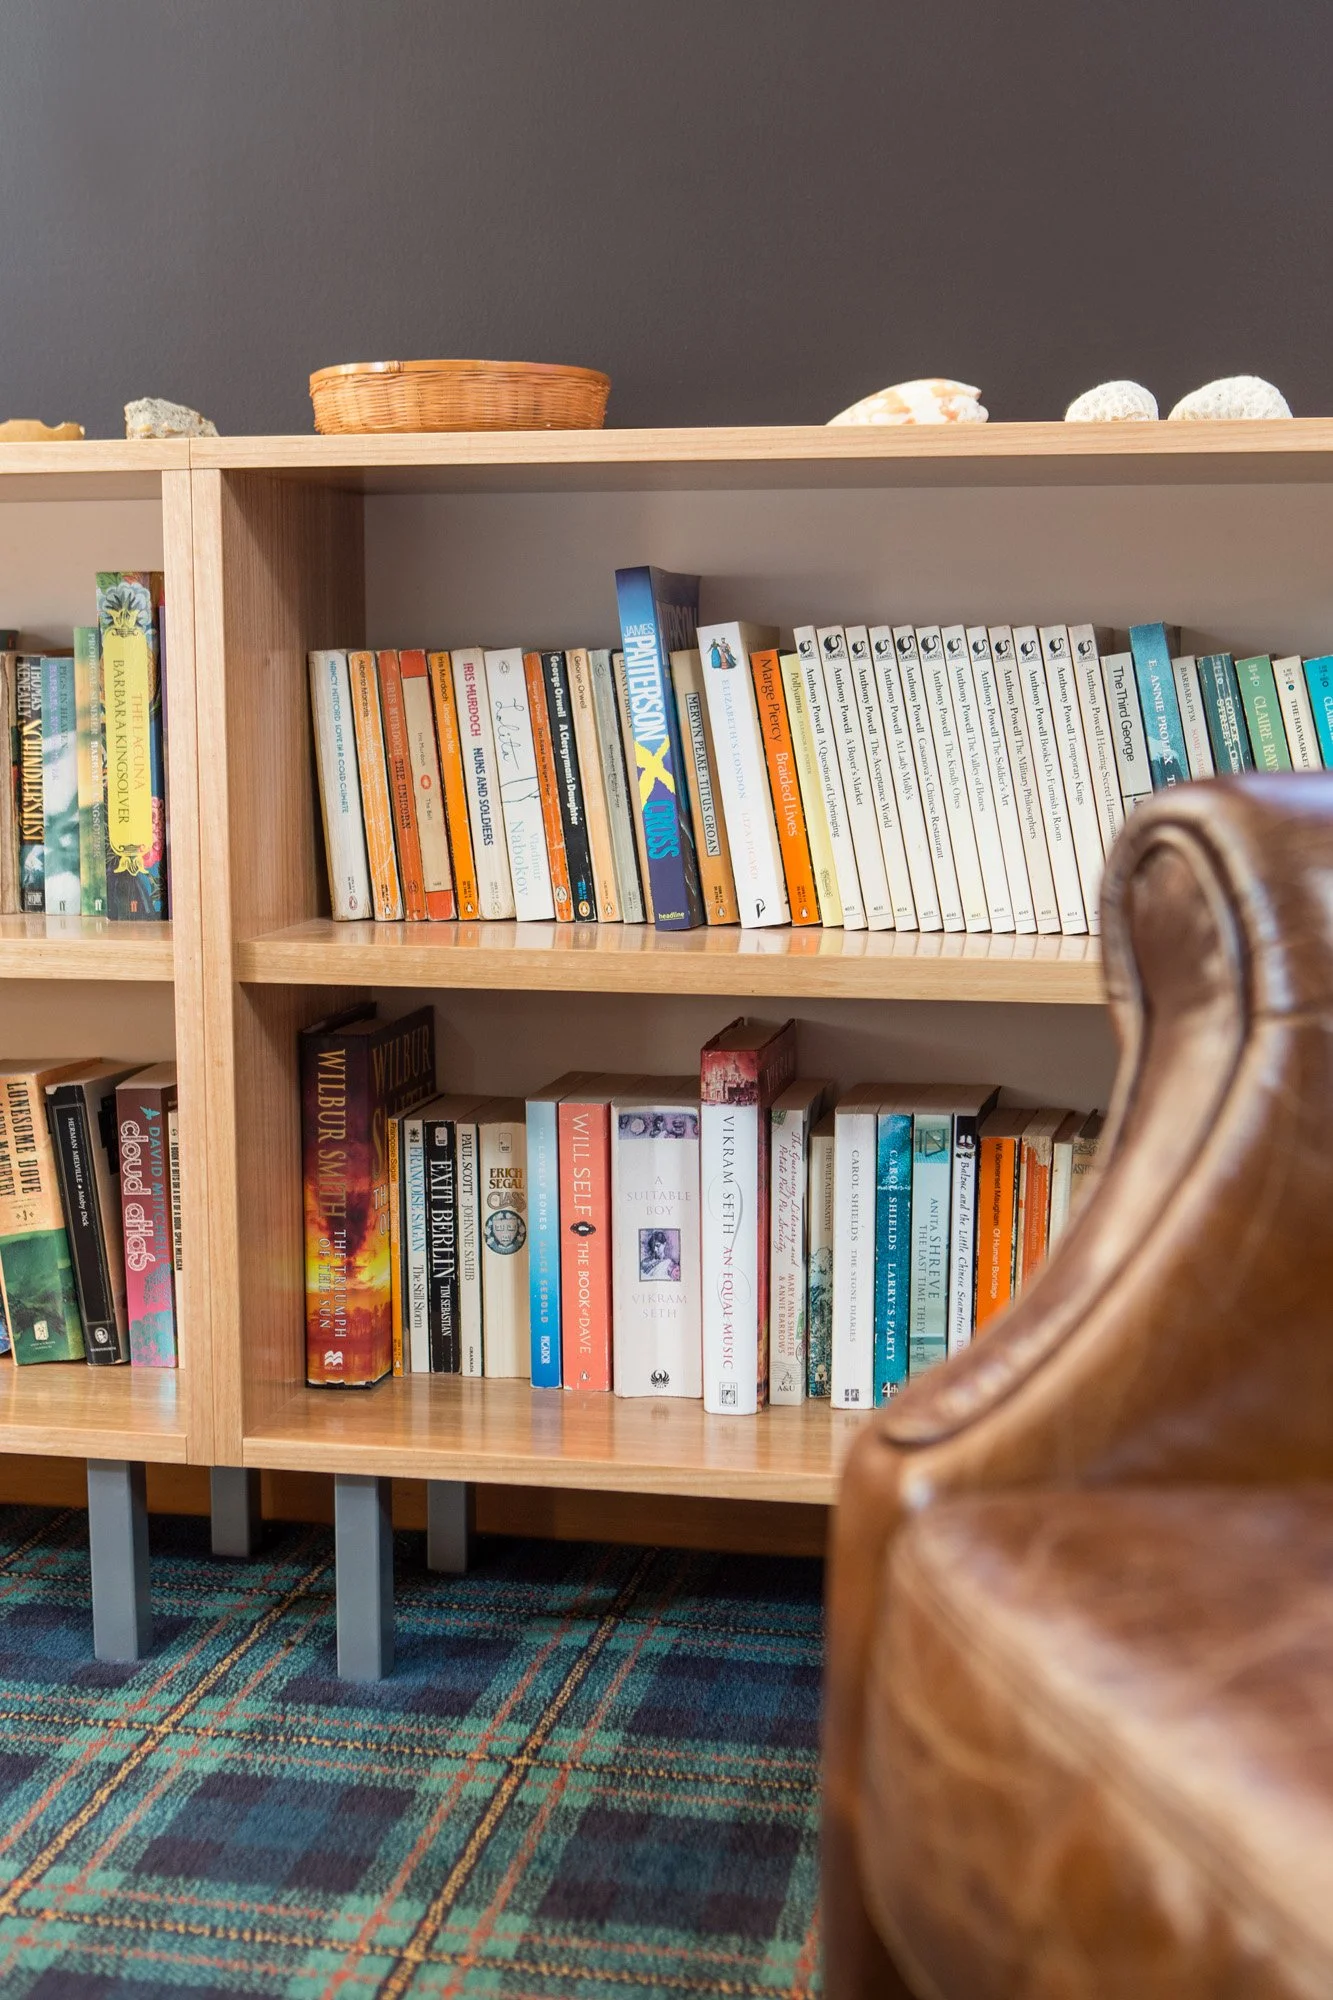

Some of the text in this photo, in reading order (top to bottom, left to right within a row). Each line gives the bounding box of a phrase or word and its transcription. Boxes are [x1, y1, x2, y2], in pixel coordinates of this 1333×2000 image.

[624, 622, 655, 637] JAMES
[17, 663, 32, 718] KENEALLY
[30, 665, 42, 710] THOMAS
[550, 656, 560, 687] George
[574, 656, 587, 709] George Orwell
[624, 635, 669, 741] PATTERSON
[790, 672, 802, 713] Pollyanna
[1150, 674, 1165, 713] ANNIE
[1180, 667, 1192, 705] BARBARA
[1187, 705, 1196, 722] PYM
[60, 707, 69, 749] HEAVEN
[555, 688, 566, 718] Orwell
[1113, 666, 1135, 762] The Third George
[1217, 698, 1232, 747] STREET
[1225, 697, 1239, 741] GOWER
[1253, 696, 1273, 741] CLAIRE
[113, 660, 130, 825] BARBARA KINGSOLVER
[131, 693, 146, 790] THE LACUNA
[387, 681, 411, 829] IRIS MURDOCH THE UNICORN
[463, 662, 494, 846] IRIS MURDOCH NUNS AND SOLDIERS
[495, 698, 525, 770] Lolita
[560, 731, 574, 784] Clergyman's
[721, 679, 746, 799] ELIZABETH'S LONDON
[760, 659, 797, 837] Marge Piercy Braided Lives
[834, 667, 863, 806] Anthony Powell A Buyer's Market
[858, 667, 893, 829] Anthony Powell The Acceptance World
[1157, 714, 1173, 765] PROULX
[1290, 699, 1310, 768] THE HAYMARKET
[687, 695, 719, 854] MERVYN PEAKE TITUS GROAN
[906, 666, 944, 858] Anthony Powell Casanova's Chinese Restaurant
[567, 784, 579, 825] Daughter
[643, 799, 680, 860] CROSS
[509, 820, 529, 896] Nabokov
[530, 832, 541, 880] Vladimir
[658, 910, 685, 919] headline
[372, 1024, 432, 1097] WILBUR
[6, 1081, 37, 1154] LONESOME
[318, 1049, 347, 1217] WILBUR SMITH
[17, 1159, 42, 1194] DOVE
[67, 1117, 90, 1227] HERMAN MELVILLE Moby Dick
[408, 1146, 424, 1211] FRANÇOISE
[430, 1160, 453, 1204] EXIT
[489, 1167, 522, 1178] ERICH
[489, 1179, 524, 1189] SEGAL
[572, 1113, 592, 1217] WILL SELF
[654, 1175, 663, 1185] A
[851, 1150, 859, 1190] CAROL
[120, 1120, 155, 1272] cloud atlas
[148, 1127, 168, 1261] DAVID MITCHELL
[461, 1133, 474, 1281] PAUL SCOTT JOHNNIE SAHIB
[627, 1191, 691, 1201] SUITABLE
[646, 1206, 673, 1215] BOY
[850, 1193, 859, 1242] SHIELDS
[411, 1213, 425, 1252] SAGAN
[431, 1208, 455, 1280] BERLIN
[577, 1241, 589, 1265] THE
[721, 1116, 735, 1370] VIKRAM SETH AN EQUAL MUSIC
[885, 1150, 898, 1362] CAROL SHIELDS LARRY'S PARTY
[928, 1198, 941, 1299] ANITA SHREVE
[956, 1161, 971, 1334] Balzac and the Little Chinese Seamstress
[319, 1238, 331, 1329] OF THE SUN
[334, 1230, 347, 1338] THE TRIUMPH
[412, 1264, 424, 1282] The
[413, 1283, 425, 1300] Still
[578, 1271, 590, 1308] BOOK
[916, 1225, 927, 1360] THE LAST TIME THEY MET
[413, 1301, 425, 1328] Storm
[440, 1285, 452, 1336] TIM SEBASTIAN
[632, 1294, 688, 1304] VIKRAM
[642, 1308, 677, 1319] SETH
[787, 1300, 795, 1316] ANN
[849, 1304, 857, 1342] DIARIES
[541, 1336, 550, 1364] PICADOR
[578, 1316, 591, 1354] DAVE
[787, 1318, 795, 1357] SHAFFER
[881, 1382, 899, 1399] 4th
